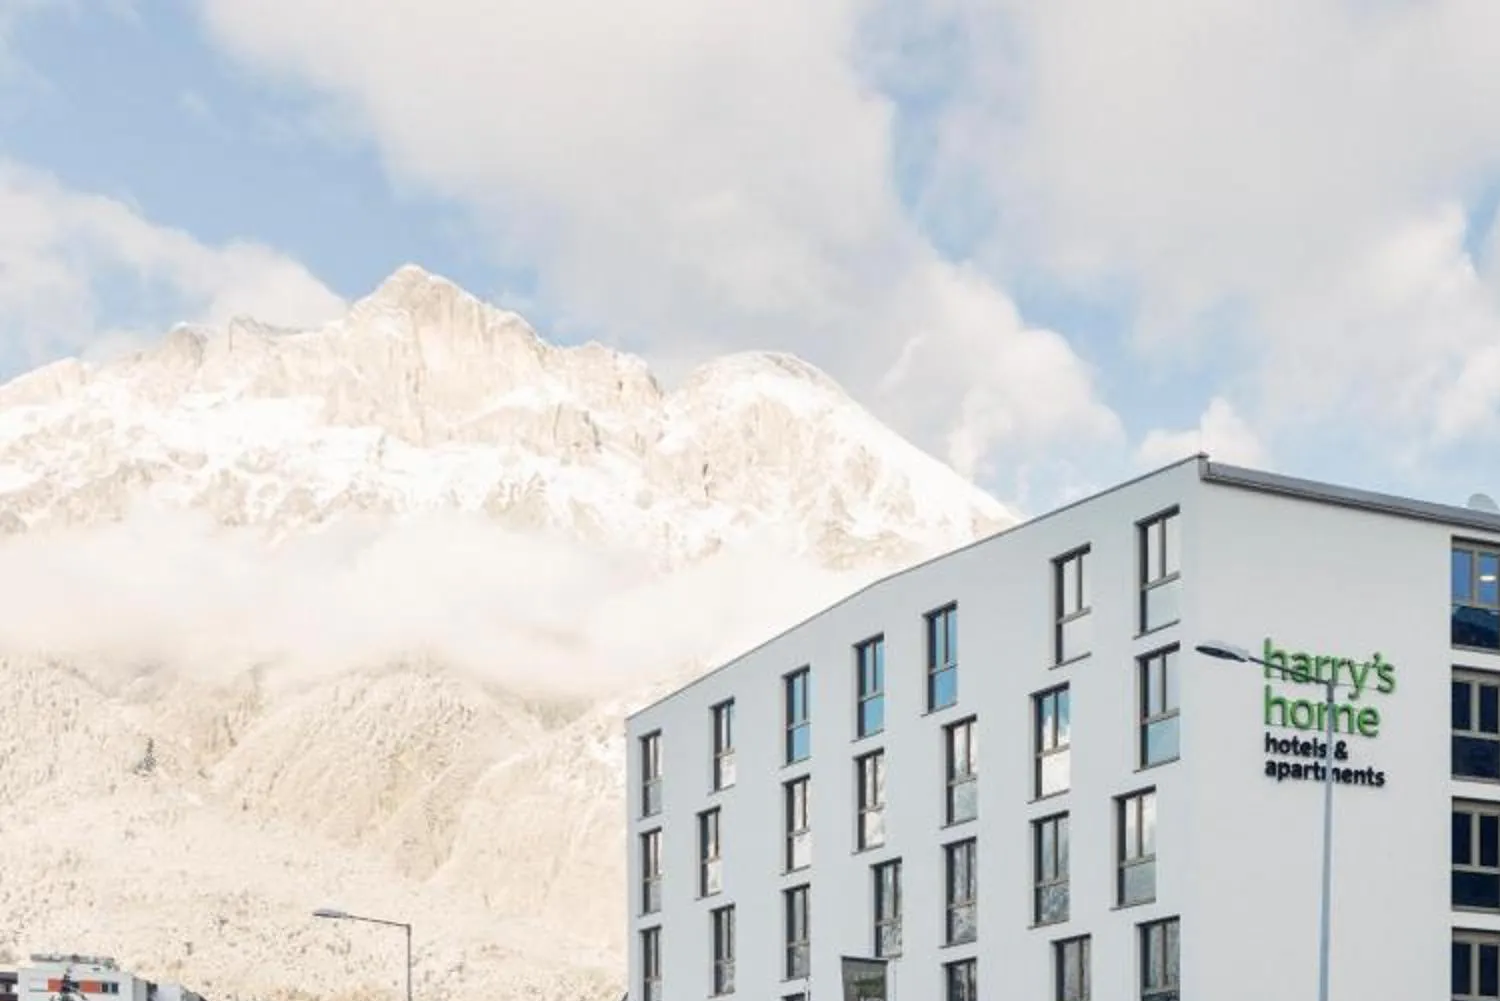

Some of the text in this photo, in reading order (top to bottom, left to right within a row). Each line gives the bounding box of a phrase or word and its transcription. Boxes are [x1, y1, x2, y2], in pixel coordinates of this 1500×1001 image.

[1263, 638, 1395, 699] harry's
[1263, 685, 1380, 737] home
[1264, 733, 1348, 760] hotels &
